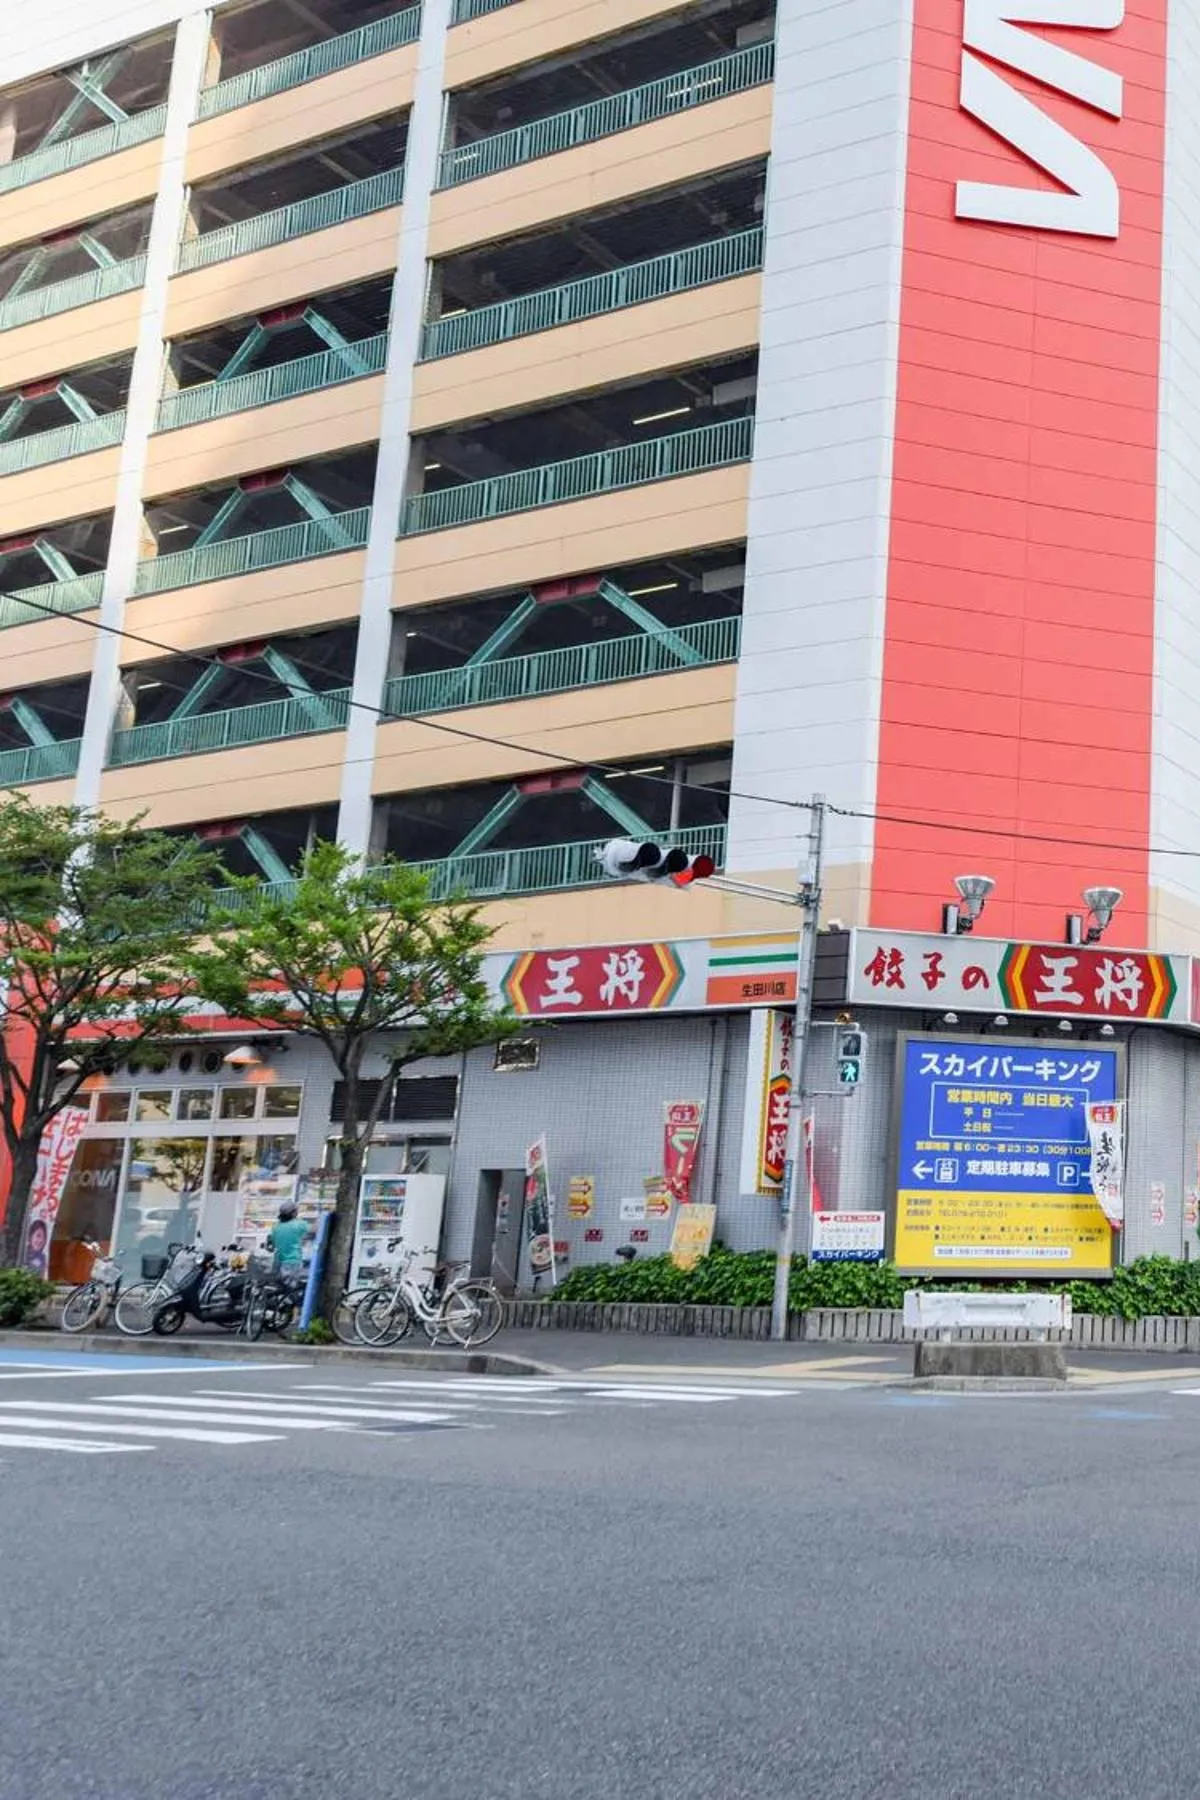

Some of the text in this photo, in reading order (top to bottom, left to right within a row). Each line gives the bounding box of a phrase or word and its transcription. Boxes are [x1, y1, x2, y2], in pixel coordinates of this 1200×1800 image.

[539, 948, 645, 1009] 王将
[740, 981, 786, 998] 生田川店
[863, 945, 1144, 1011] 餃子の 王将
[919, 1053, 1101, 1083] スカイパーキング
[1063, 1166, 1075, 1182] P
[817, 1250, 880, 1259] スカイパーキング
